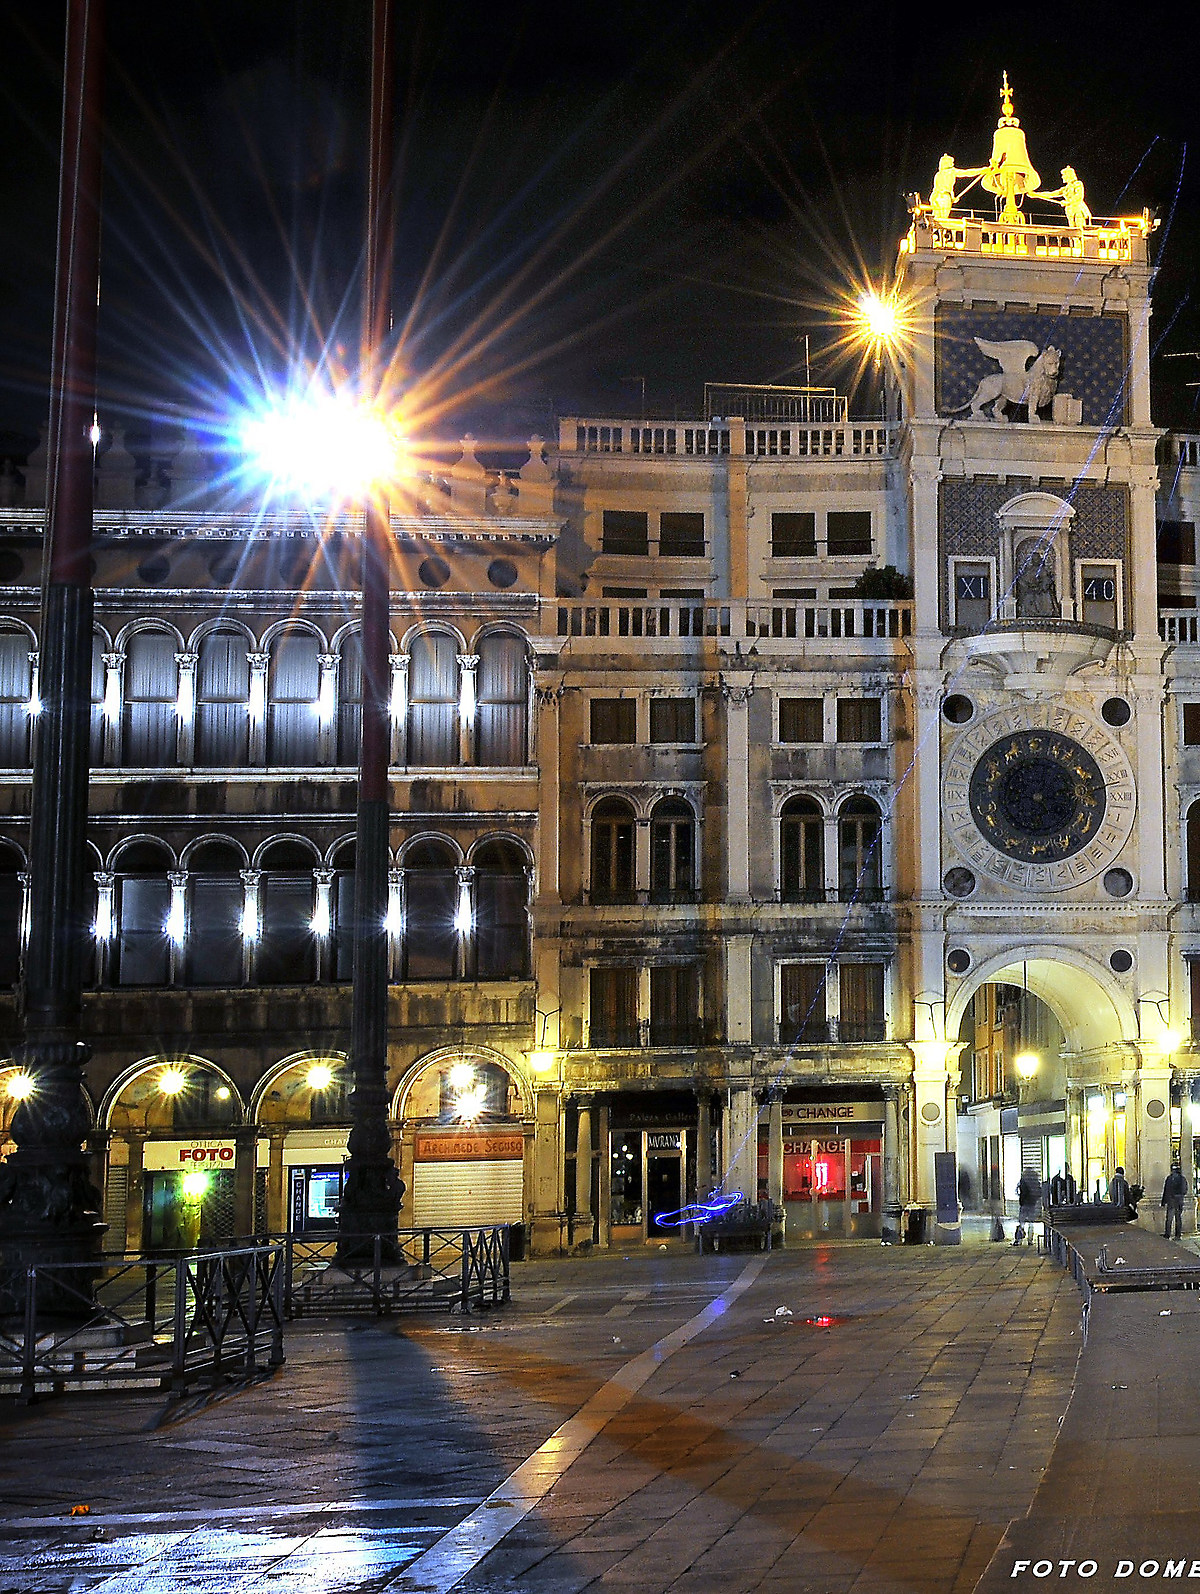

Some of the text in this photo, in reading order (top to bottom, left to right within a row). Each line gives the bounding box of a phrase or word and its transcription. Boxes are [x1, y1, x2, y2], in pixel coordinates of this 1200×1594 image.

[961, 577, 985, 598] XI
[1084, 579, 1115, 601] 40
[796, 1106, 854, 1119] CHANGE
[179, 1147, 234, 1162] FOTO
[783, 1140, 846, 1154] CHANGE
